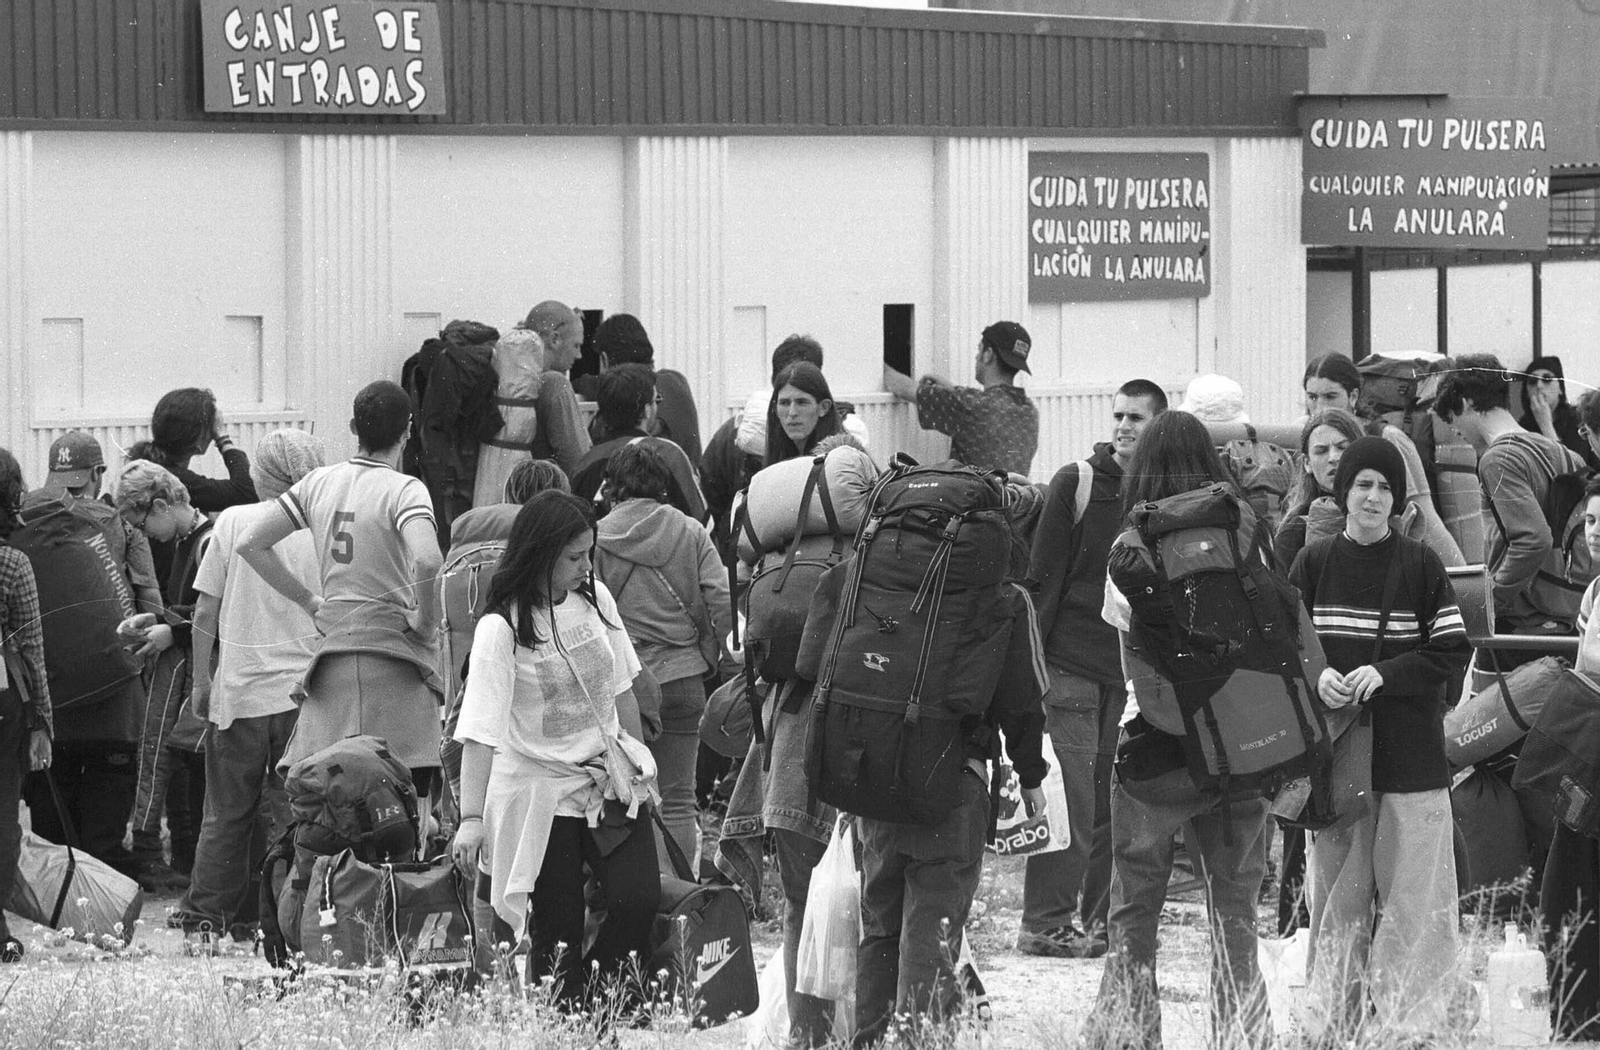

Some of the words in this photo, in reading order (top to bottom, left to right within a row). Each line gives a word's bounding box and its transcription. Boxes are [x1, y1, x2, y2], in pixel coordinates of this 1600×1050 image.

[223, 4, 347, 54] CANJE
[373, 9, 423, 52] DE
[226, 57, 427, 112] ENTRADAS
[1310, 117, 1389, 150] CUIDA
[1397, 117, 1434, 149] TU
[1441, 117, 1546, 151] PULSERA
[1029, 175, 1089, 209] CUIDA
[1093, 176, 1120, 210] TU
[1123, 176, 1209, 211] PULSERA
[1416, 167, 1550, 200] MANIPULACIÓN
[1031, 217, 1132, 245] CUALQUIER
[1348, 206, 1374, 233] LA
[1393, 199, 1505, 237] ANULARÁ
[1104, 255, 1126, 284] LA
[330, 510, 355, 565] 5
[83, 531, 135, 620] NORTHBROO
[1454, 716, 1499, 748] LOCUST
[986, 825, 1049, 857] prabo
[700, 936, 731, 965] NIKE
